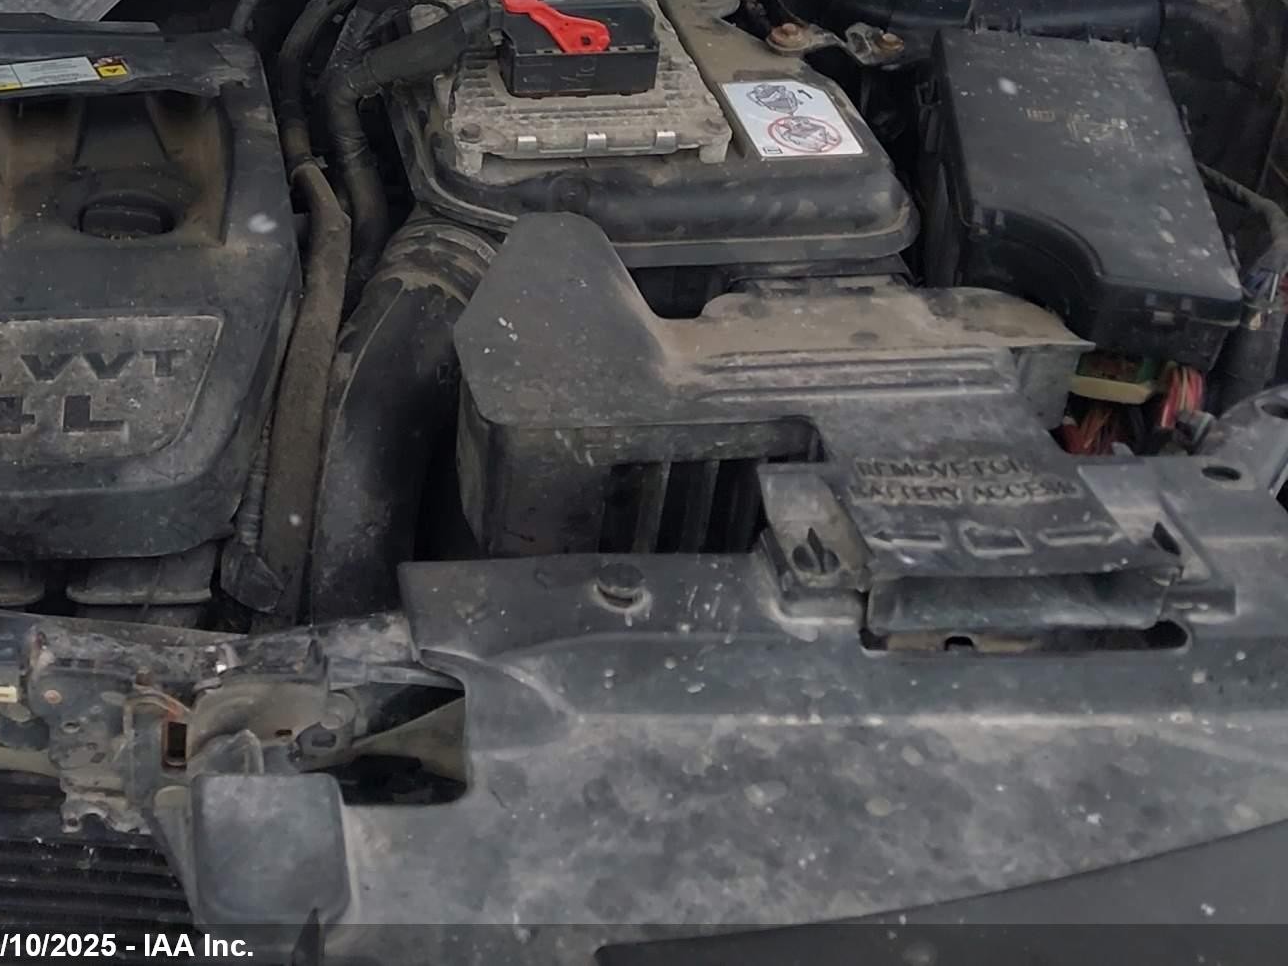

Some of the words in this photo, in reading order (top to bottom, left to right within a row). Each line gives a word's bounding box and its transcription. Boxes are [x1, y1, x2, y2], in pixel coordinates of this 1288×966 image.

[19, 349, 187, 382] VVT
[855, 459, 964, 478] REMOVE
[848, 483, 962, 502] BATTERY
